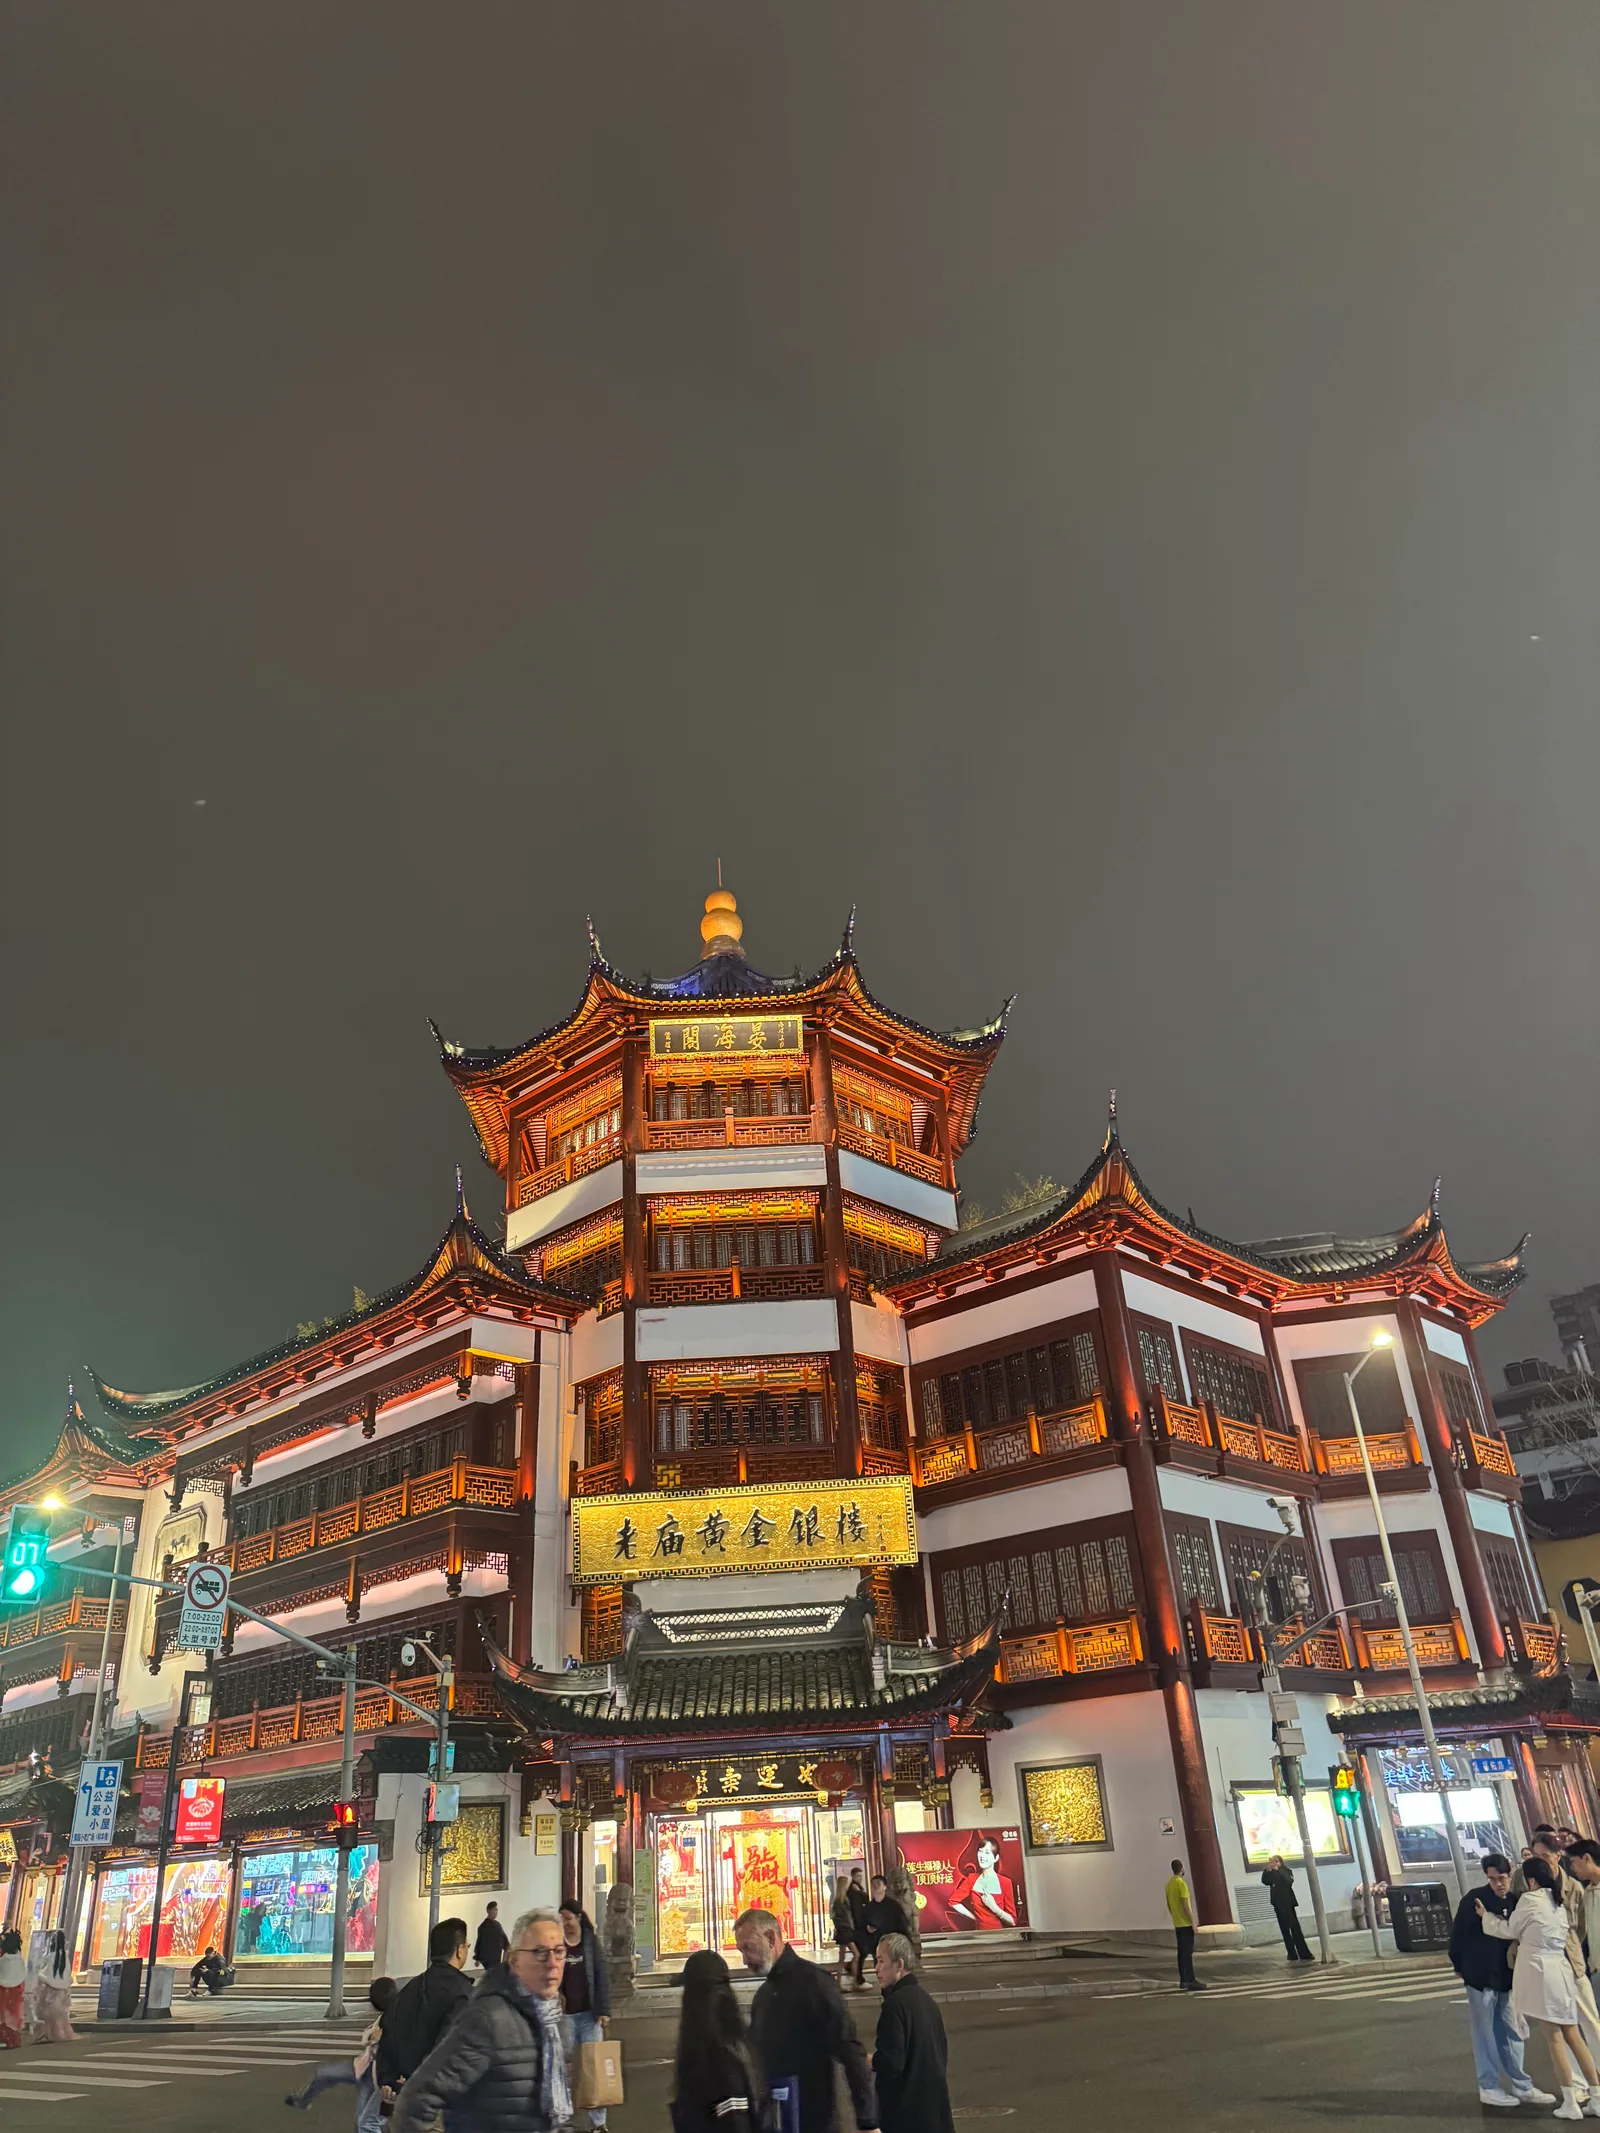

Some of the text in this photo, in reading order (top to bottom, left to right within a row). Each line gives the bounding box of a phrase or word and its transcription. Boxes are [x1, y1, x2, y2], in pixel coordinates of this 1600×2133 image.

[12, 1542, 38, 1565] 07
[181, 1634, 218, 1645] 大型号牌
[93, 1791, 114, 1802] 公益
[91, 1804, 112, 1816] 爱心
[89, 1818, 110, 1830] 小屋
[744, 1845, 777, 1869] 马上
[745, 1861, 780, 1884] 有财
[915, 1872, 954, 1885] 顶顶好运
